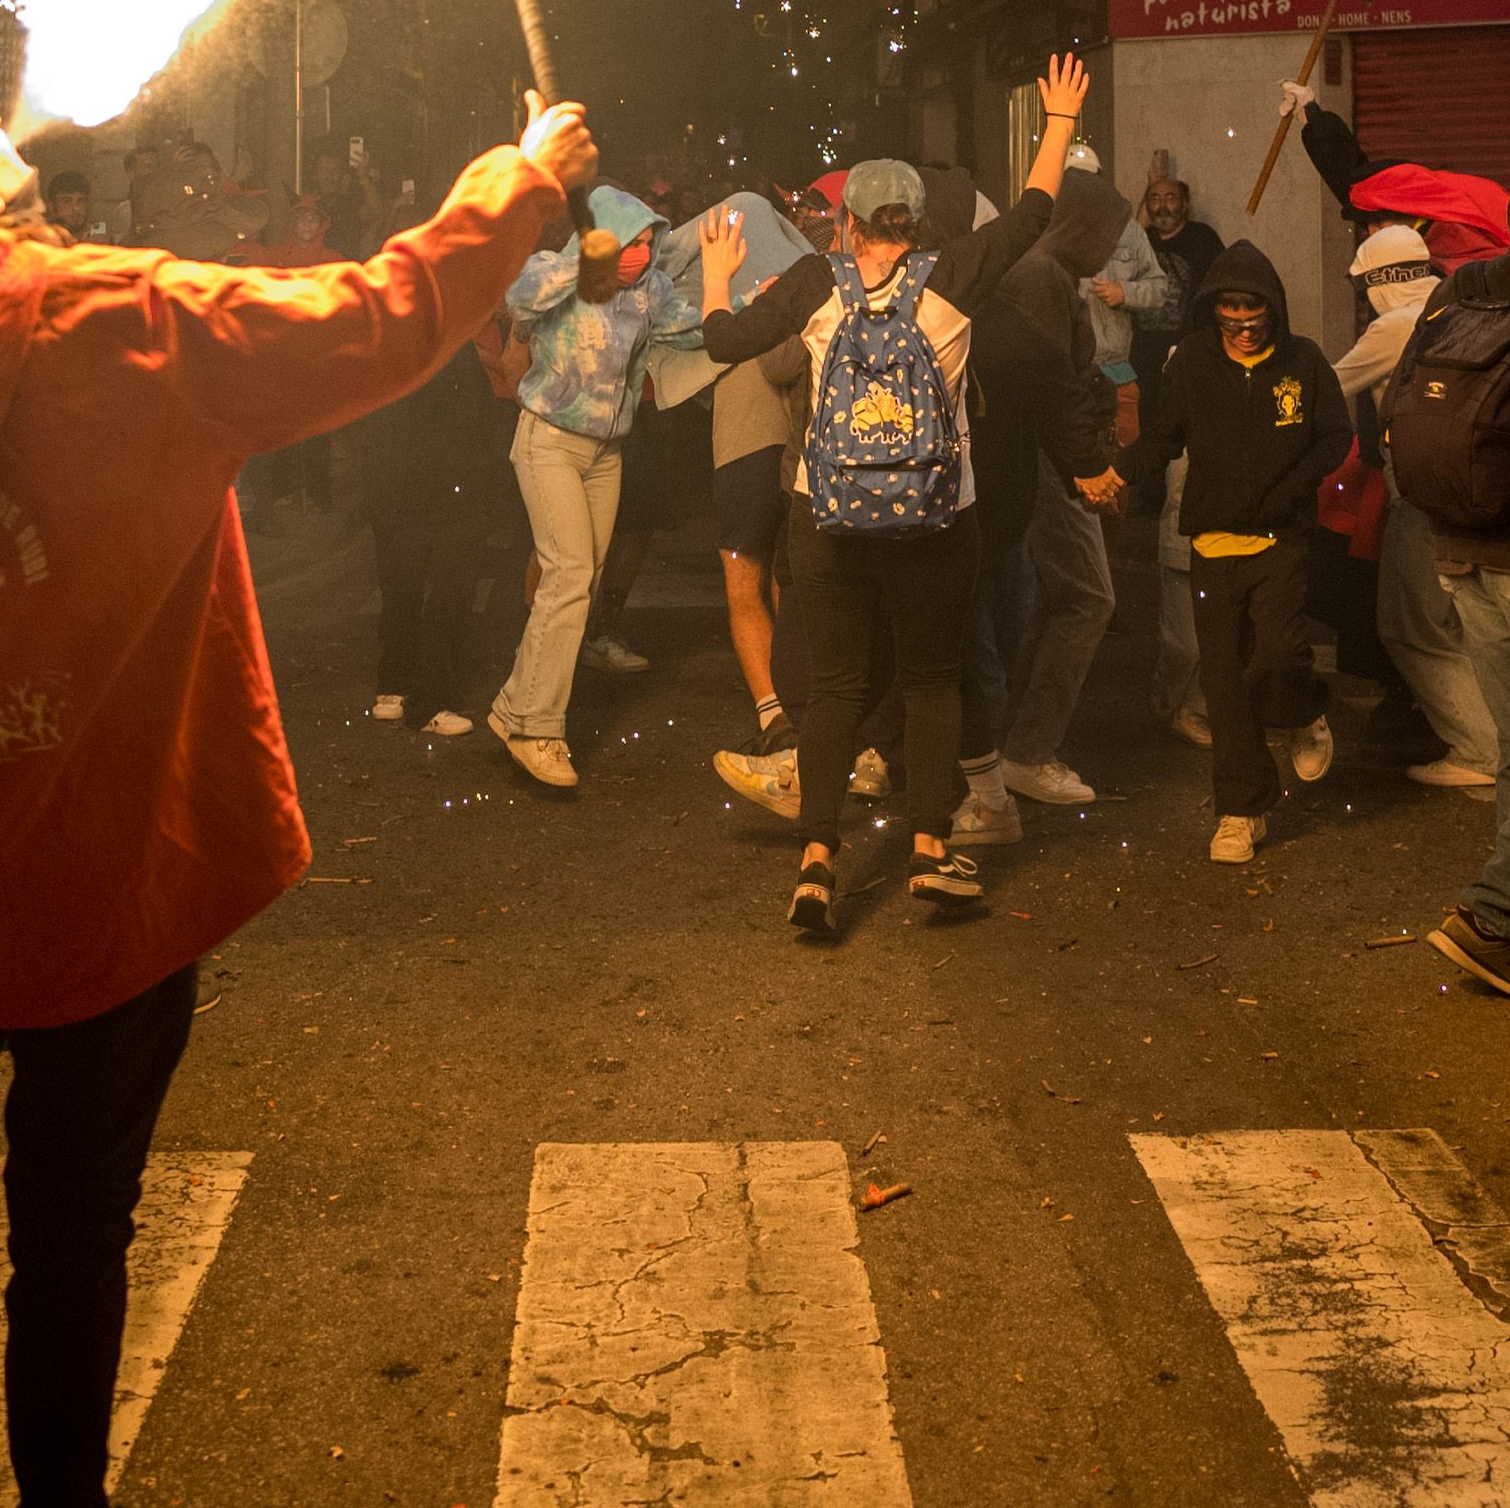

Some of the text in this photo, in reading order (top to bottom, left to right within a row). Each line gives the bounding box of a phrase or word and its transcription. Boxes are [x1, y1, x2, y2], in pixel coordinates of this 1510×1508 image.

[1297, 15, 1320, 28] DON
[1338, 12, 1370, 25] HOME
[1381, 9, 1412, 24] NENS
